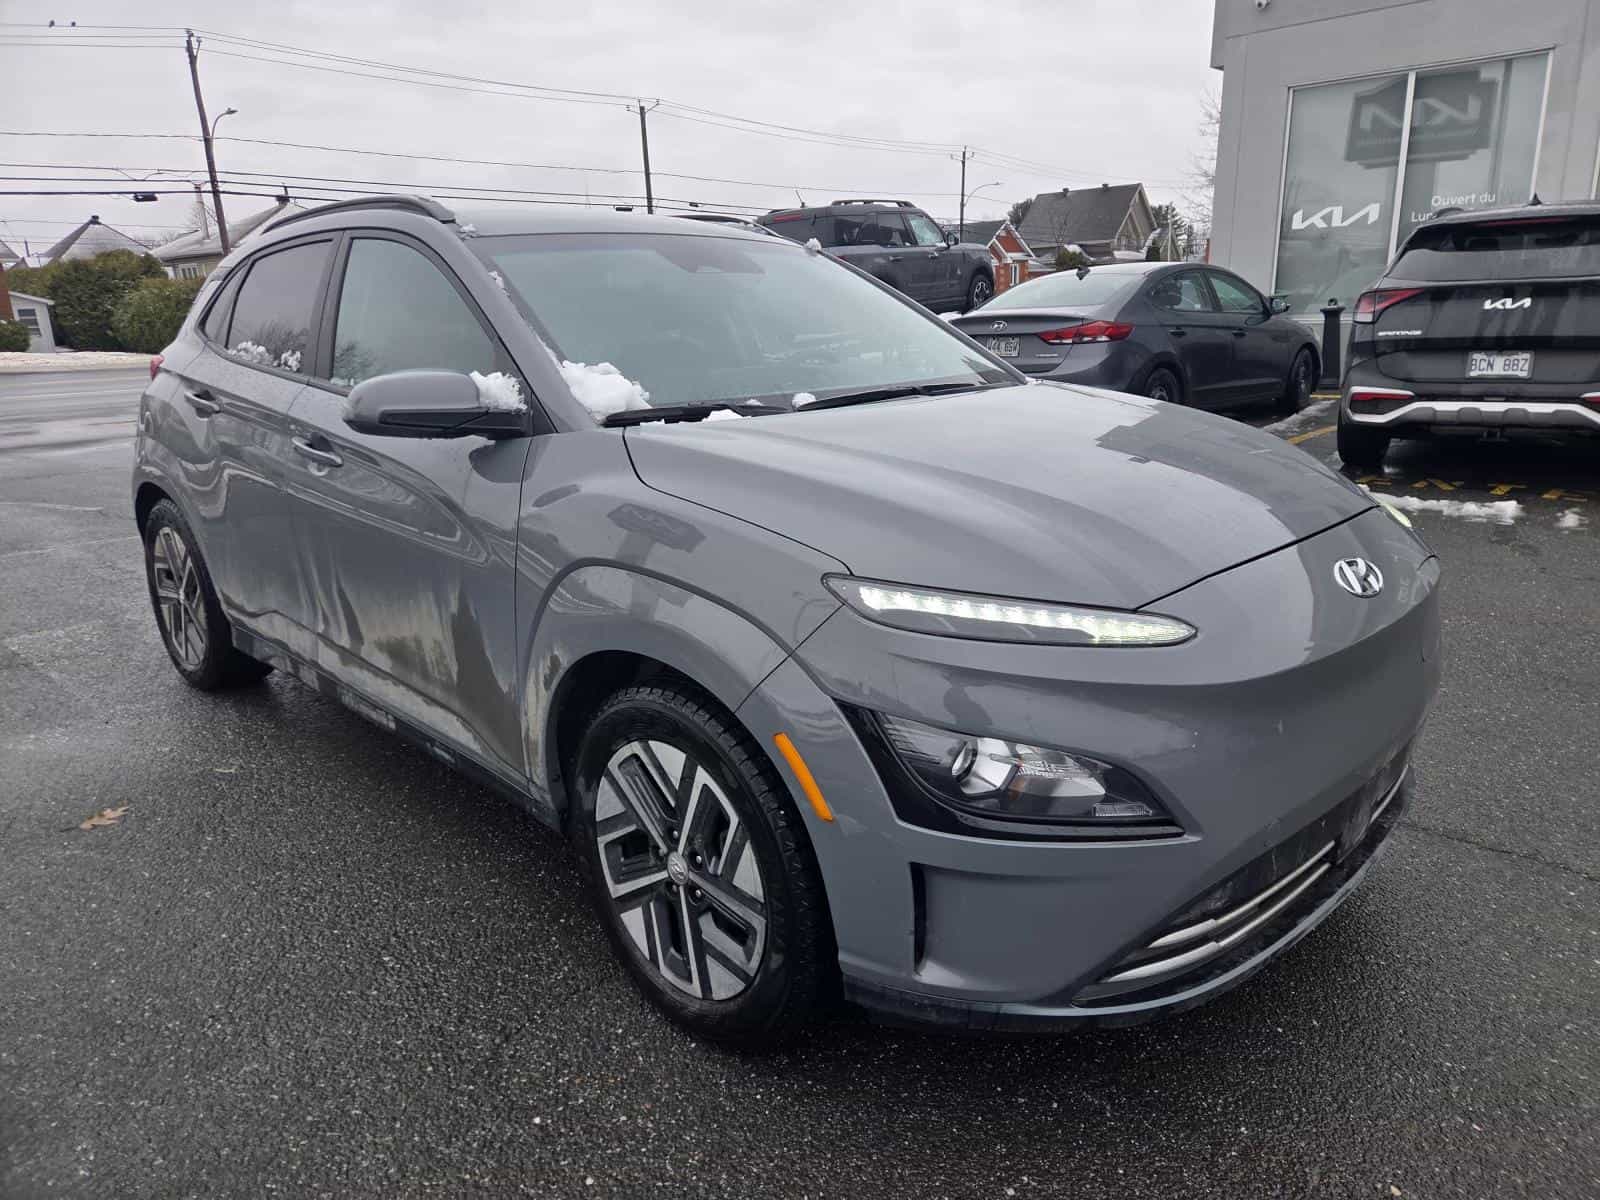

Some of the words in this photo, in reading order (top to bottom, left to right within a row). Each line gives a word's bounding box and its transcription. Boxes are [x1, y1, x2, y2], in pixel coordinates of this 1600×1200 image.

[1431, 194, 1476, 207] Ouvert
[1479, 191, 1496, 203] du
[1292, 203, 1380, 230] KIA
[1483, 297, 1532, 311] KIA
